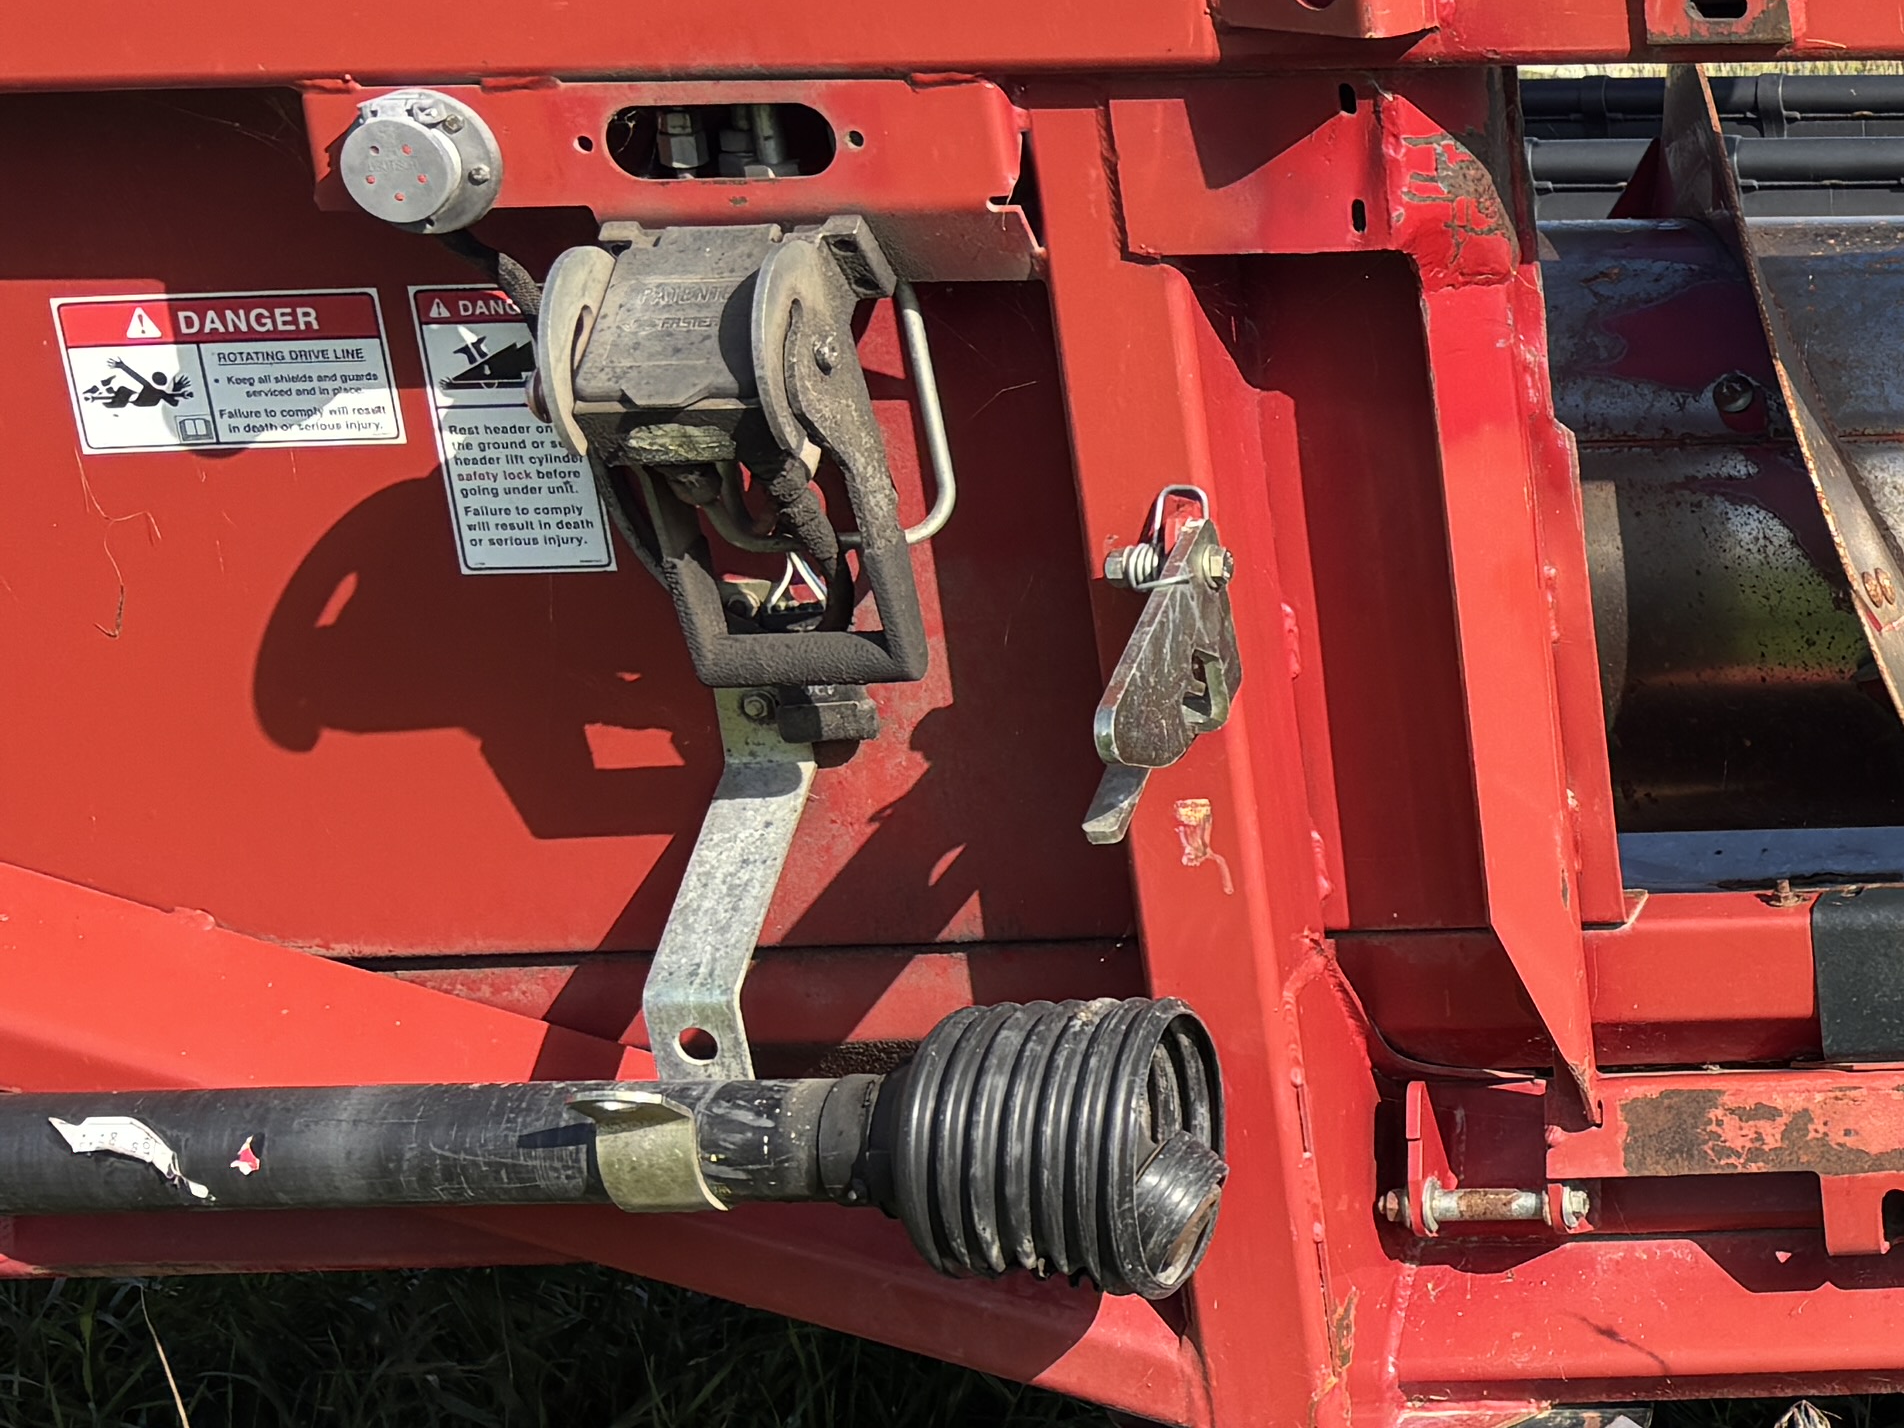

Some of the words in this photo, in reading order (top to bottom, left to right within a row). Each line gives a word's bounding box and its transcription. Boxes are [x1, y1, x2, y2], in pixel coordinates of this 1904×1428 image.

[639, 284, 731, 306] PATENTE
[459, 300, 522, 316] DANG
[177, 307, 320, 334] DANGER
[217, 350, 285, 363] ROTATING
[290, 349, 330, 361] DRIVE
[334, 348, 364, 360] LINE
[227, 375, 255, 386] Keep
[258, 375, 272, 384] all
[274, 374, 314, 384] shields
[317, 373, 337, 383] and
[340, 372, 379, 383] guards
[246, 388, 292, 398] serviced
[295, 387, 316, 396] and
[319, 386, 330, 396] in
[219, 408, 262, 419] Failure
[264, 408, 277, 418] to
[280, 406, 323, 420] comply
[329, 405, 349, 416] will
[352, 406, 386, 415] result
[229, 424, 240, 434] in
[243, 423, 278, 433] death
[280, 424, 294, 432] or
[298, 422, 342, 432] serious
[345, 421, 383, 433] injury.
[448, 425, 480, 435] Rest
[484, 424, 530, 434] header
[536, 425, 553, 434] on
[452, 441, 473, 451] the
[478, 440, 527, 452] ground
[532, 441, 545, 449] or
[455, 455, 500, 465] header
[505, 454, 525, 465] lift
[529, 454, 583, 467] cylinder
[457, 471, 499, 483] safety
[503, 470, 533, 480] lock
[536, 470, 581, 479] before
[460, 485, 499, 498] going
[503, 485, 542, 495] under
[549, 483, 578, 494] unit.
[464, 506, 512, 516] Failure
[515, 506, 529, 515] to
[534, 505, 583, 517] comply
[467, 521, 490, 531] will
[495, 521, 535, 531] result
[540, 520, 551, 530] in
[556, 520, 594, 530] death
[469, 538, 483, 546] or
[488, 536, 539, 546] serious
[543, 535, 588, 548] injury.
